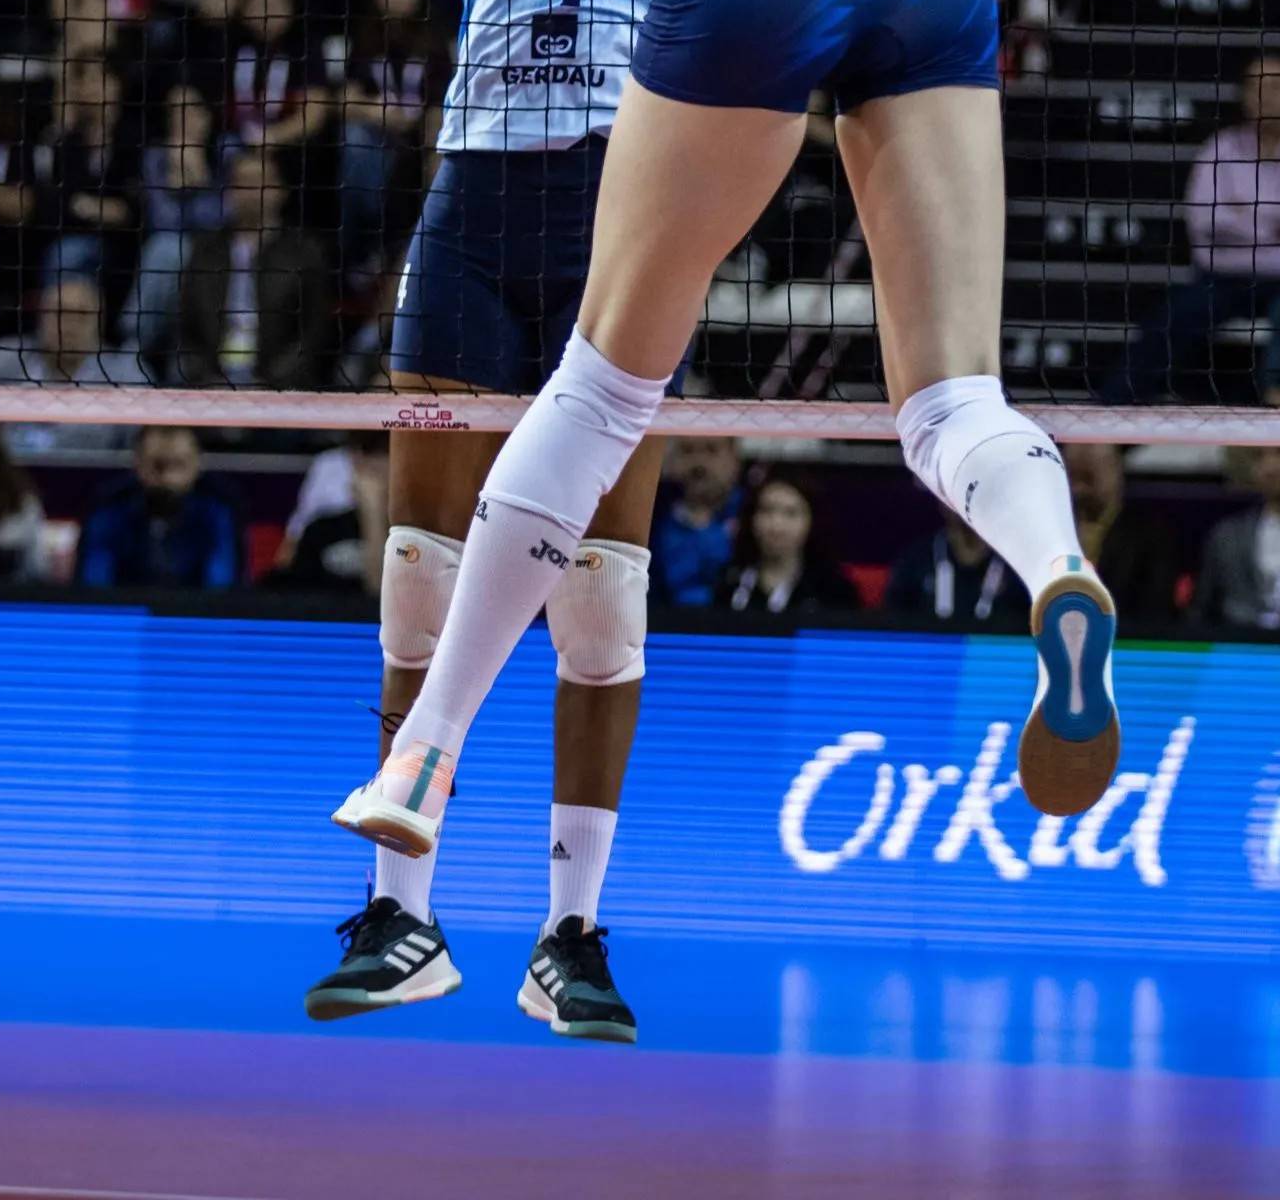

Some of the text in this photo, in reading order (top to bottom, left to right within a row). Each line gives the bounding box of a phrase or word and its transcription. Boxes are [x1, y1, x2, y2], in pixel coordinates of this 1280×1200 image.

[501, 65, 606, 88] GERDAU
[398, 409, 452, 420] CLUB
[381, 420, 421, 429] WORLD
